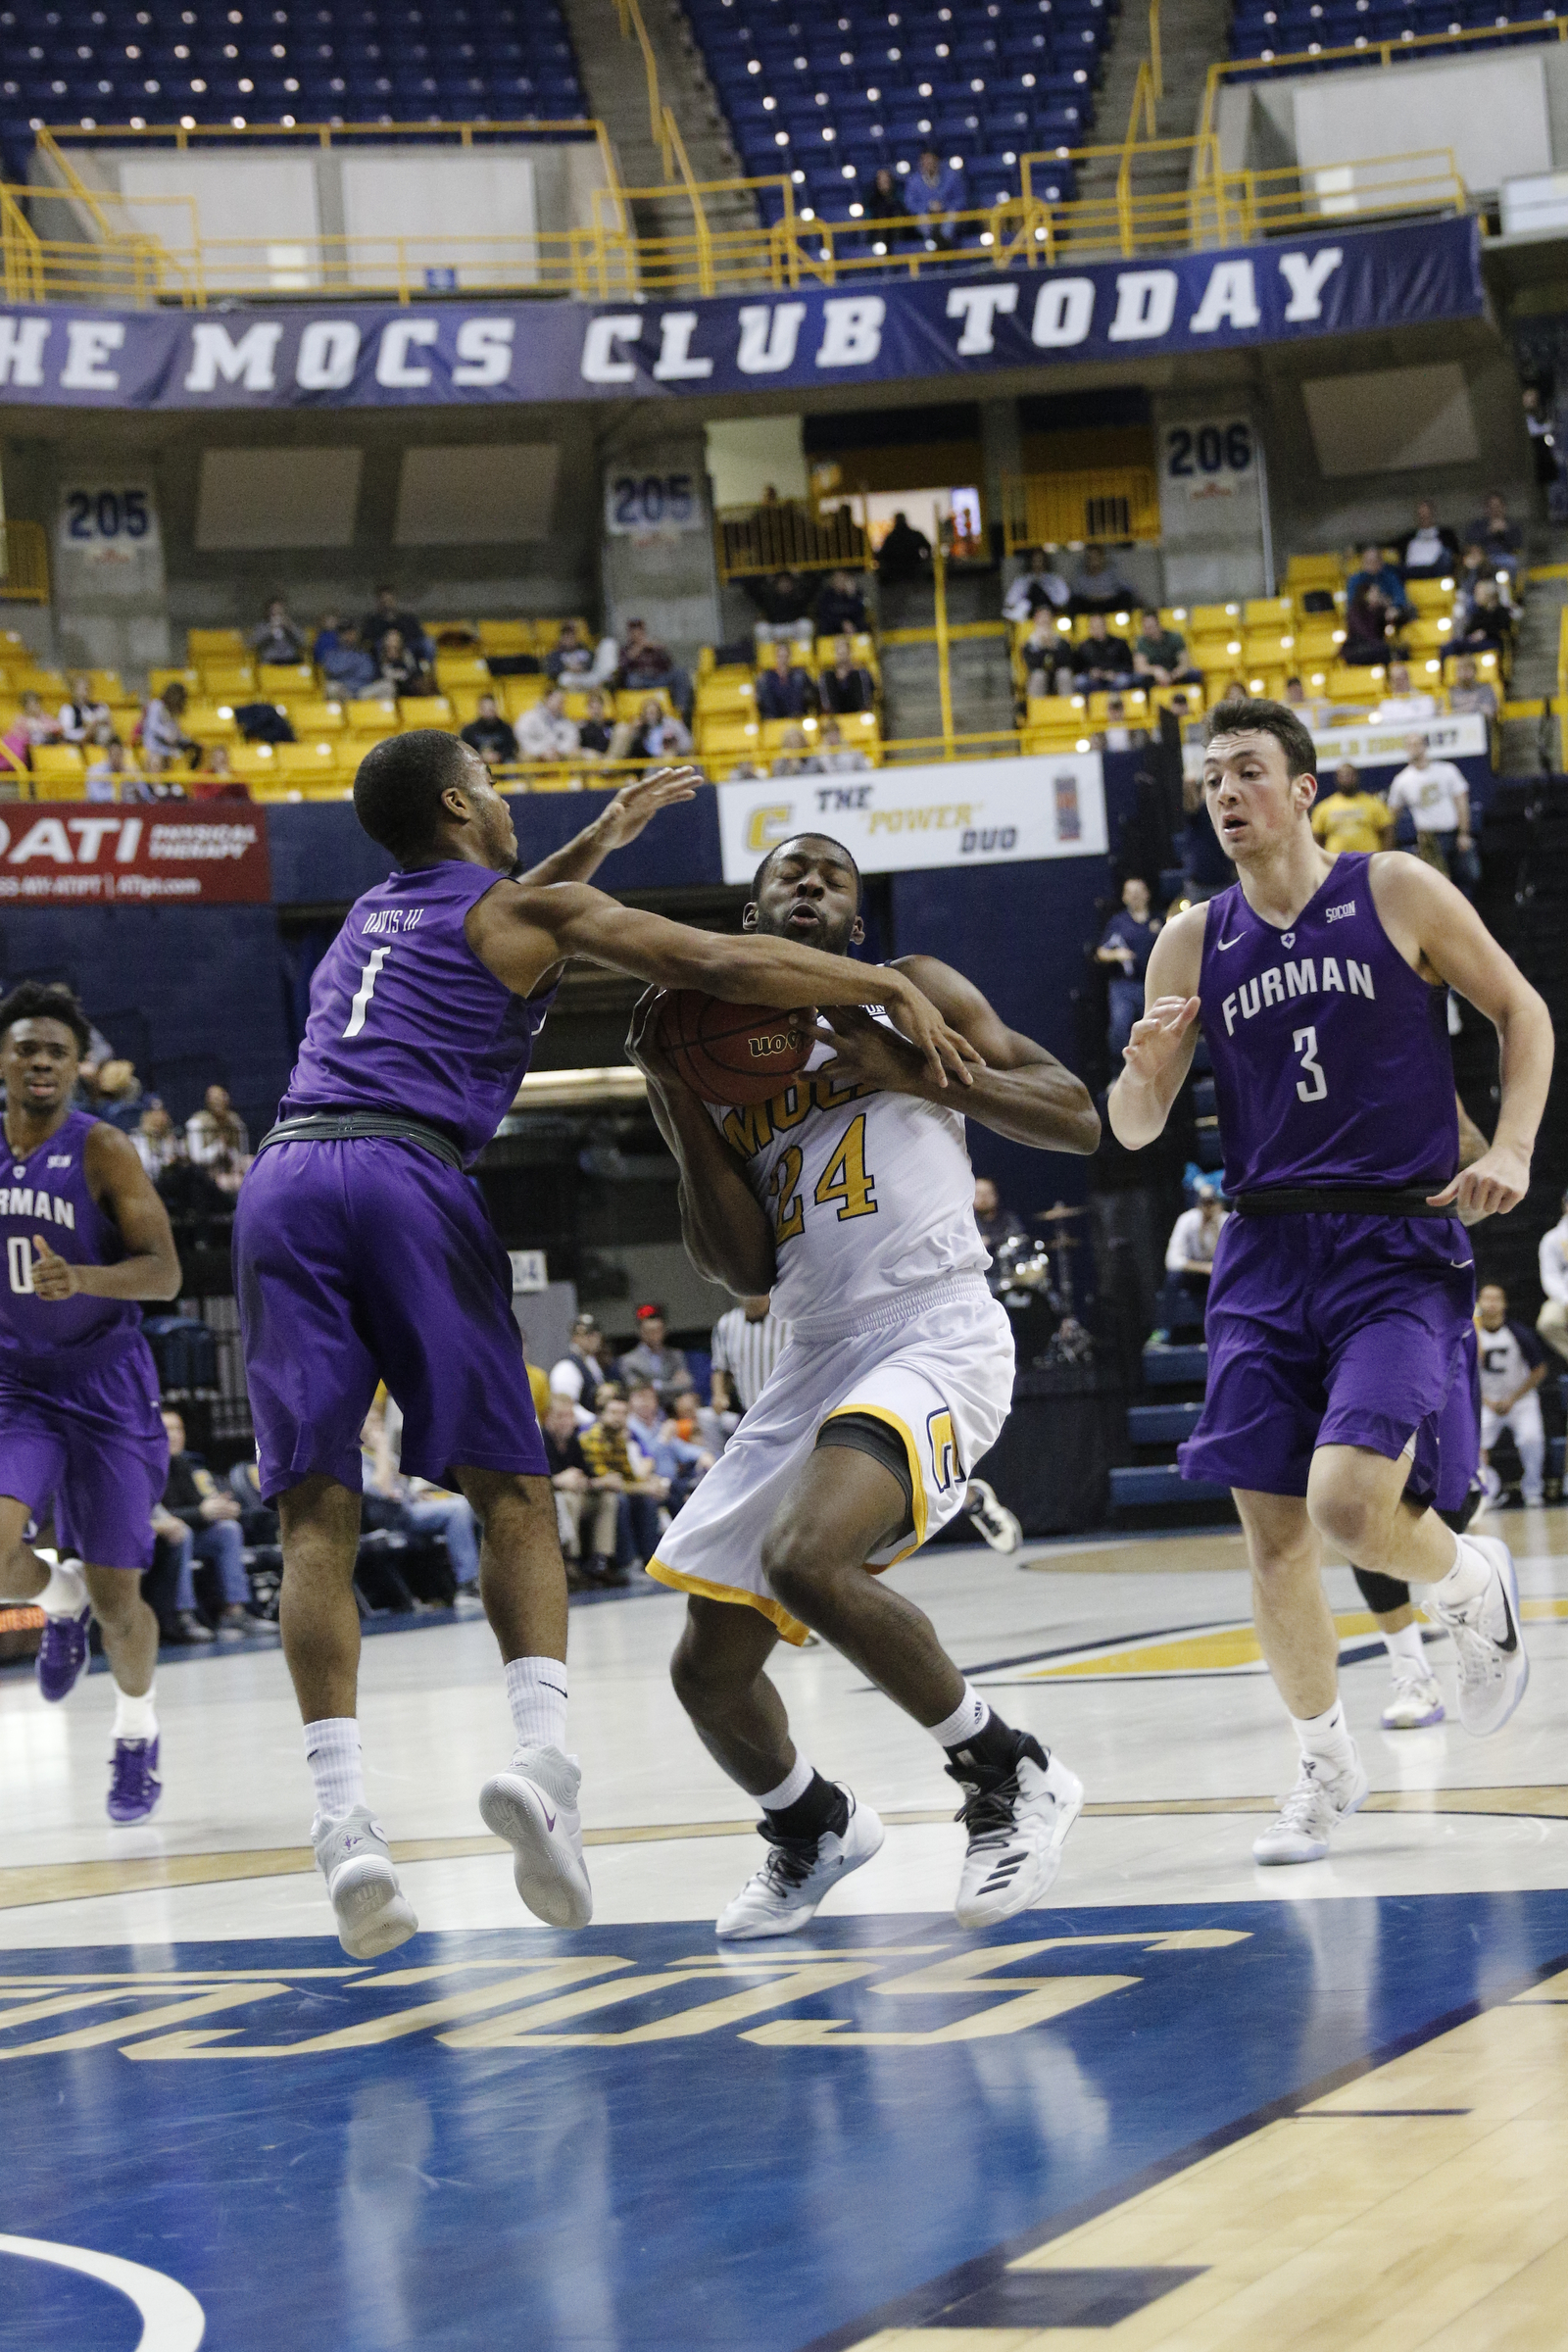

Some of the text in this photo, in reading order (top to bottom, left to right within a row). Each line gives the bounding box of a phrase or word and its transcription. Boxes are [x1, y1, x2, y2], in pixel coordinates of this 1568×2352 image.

[184, 318, 515, 392] MOCS
[581, 295, 886, 383] CLUB
[944, 247, 1344, 356] TODAY
[1168, 423, 1250, 478] 206
[67, 490, 149, 540] 205
[613, 474, 692, 524] 205
[815, 786, 872, 812] THE
[7, 816, 144, 864] ATI
[959, 825, 1019, 855] DUO
[361, 907, 425, 935] DAVIS III
[341, 945, 392, 1039] 1
[1221, 956, 1376, 1037] FURMAN
[1292, 1025, 1328, 1102] 3
[722, 1056, 885, 1161] MOC
[767, 1112, 879, 1248] 24
[7, 1236, 35, 1295] 0
[1483, 1347, 1509, 1375] C
